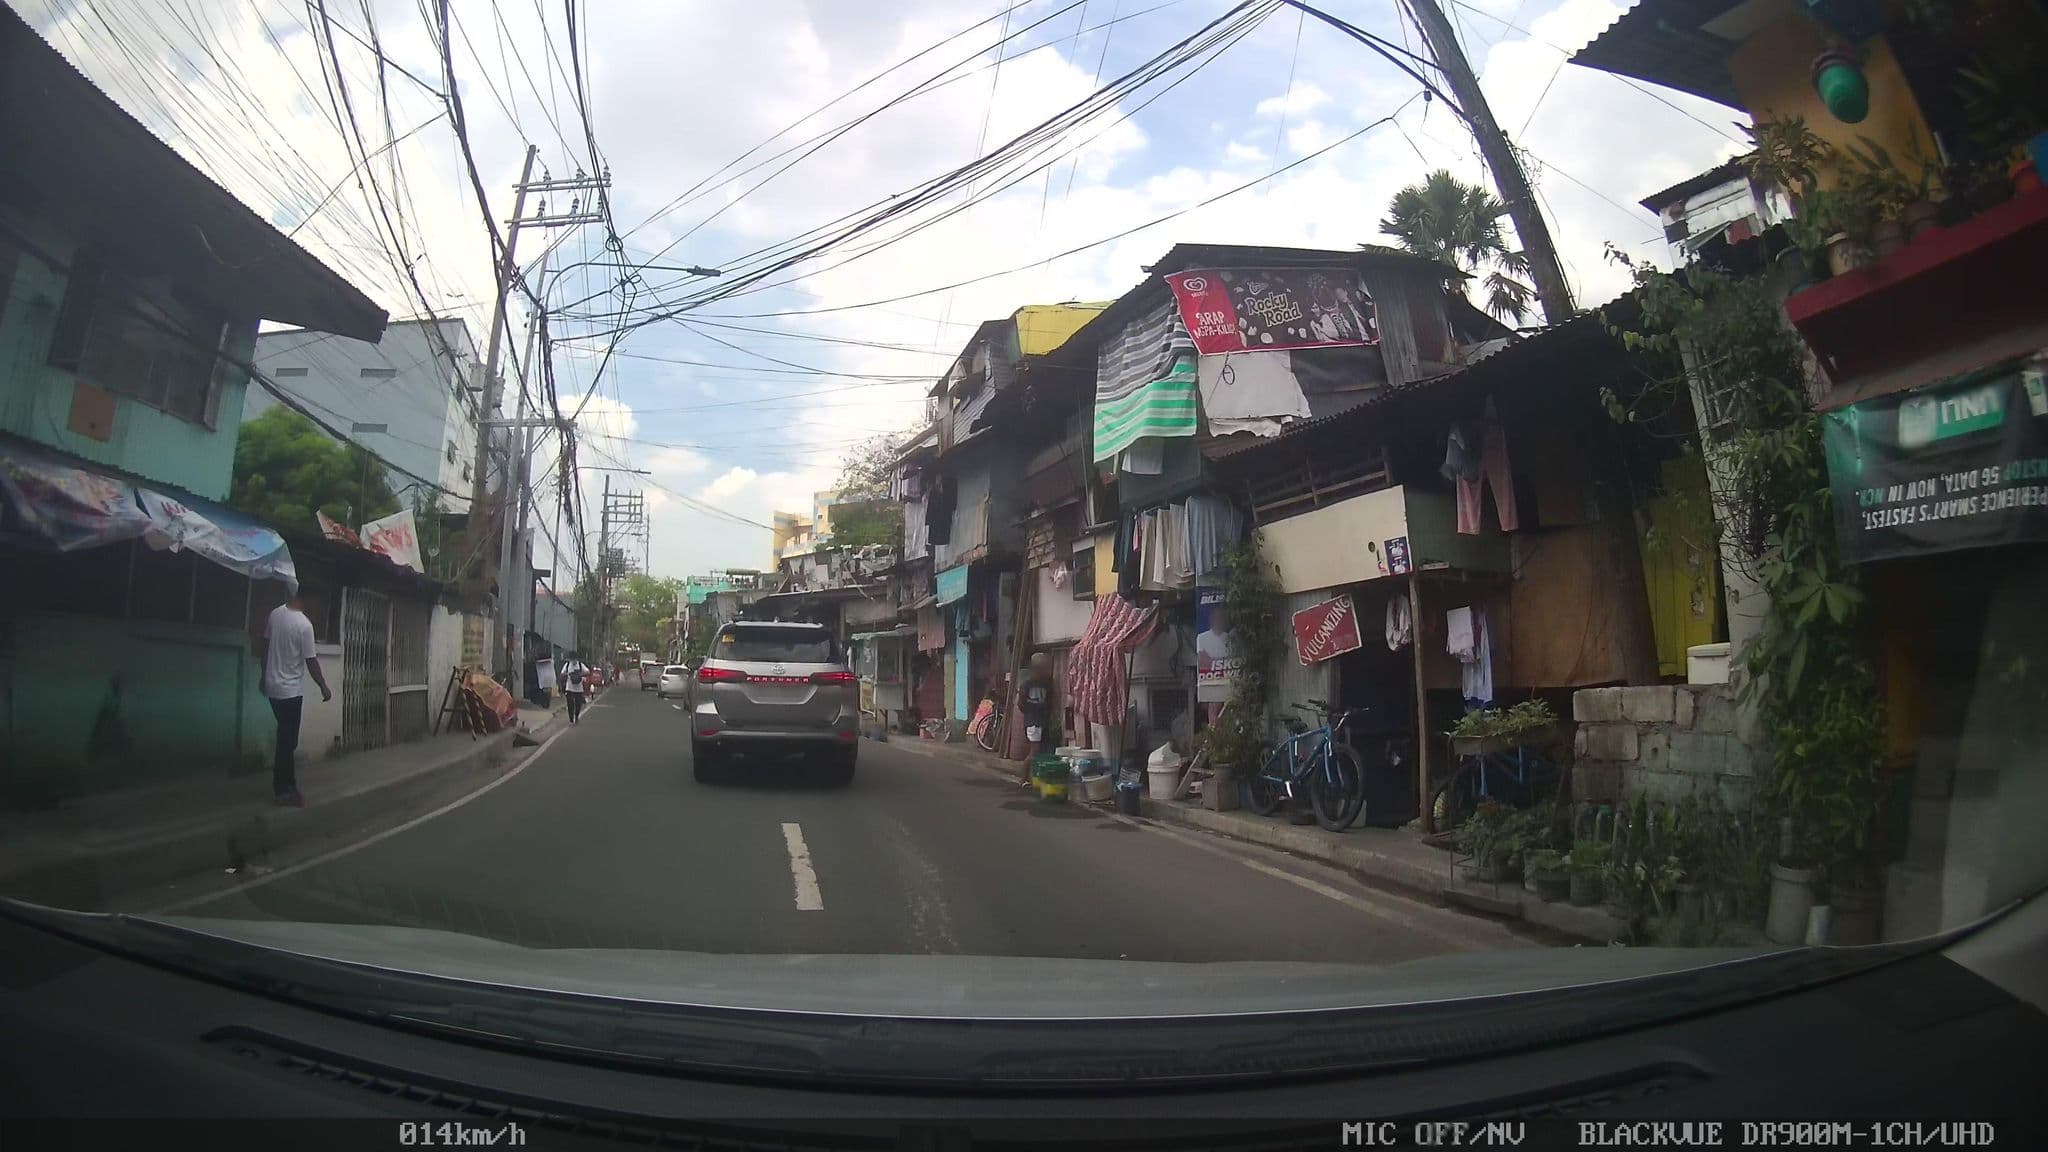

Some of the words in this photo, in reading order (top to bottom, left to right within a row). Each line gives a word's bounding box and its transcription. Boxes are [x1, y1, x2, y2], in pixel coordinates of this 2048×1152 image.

[1244, 292, 1288, 316] Rocky
[1263, 302, 1302, 327] Road
[1940, 386, 2000, 425] UNLI
[1940, 470, 1978, 493] DATA,
[1982, 466, 2000, 486] 5G
[1888, 484, 1903, 502] IN
[1906, 478, 1936, 500] NOW
[1862, 506, 1916, 530] FASTEST,
[1919, 497, 1979, 521] SMART'S
[1302, 598, 1350, 662] VULCANIZING
[1211, 657, 1243, 671] ISKO
